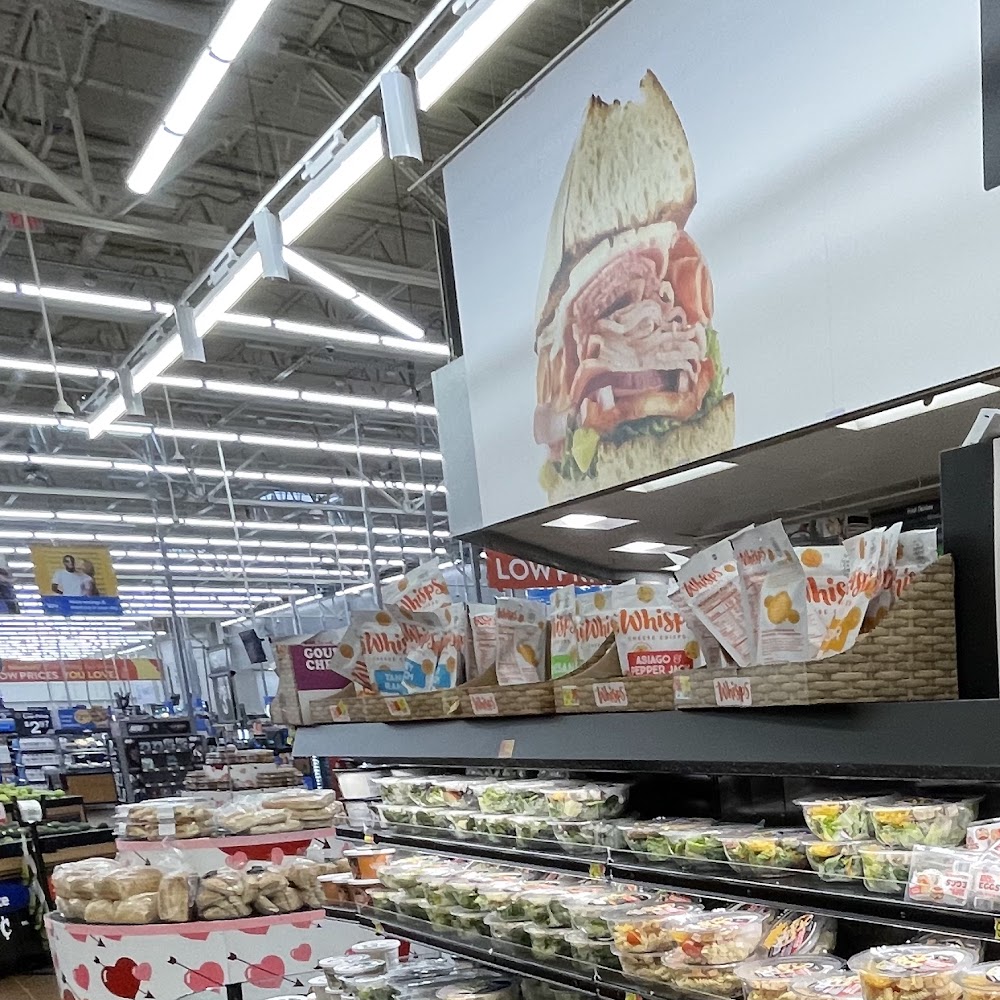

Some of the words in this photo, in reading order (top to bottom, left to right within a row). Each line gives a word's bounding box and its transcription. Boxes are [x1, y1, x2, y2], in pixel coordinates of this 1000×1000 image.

[496, 557, 550, 581] LOW
[620, 608, 684, 635] Whisp
[303, 647, 338, 660] GOU
[636, 654, 671, 665] ASIAGO
[630, 664, 666, 675] PEPPER
[20, 671, 59, 680] PRICES
[978, 882, 1000, 891] EGGS
